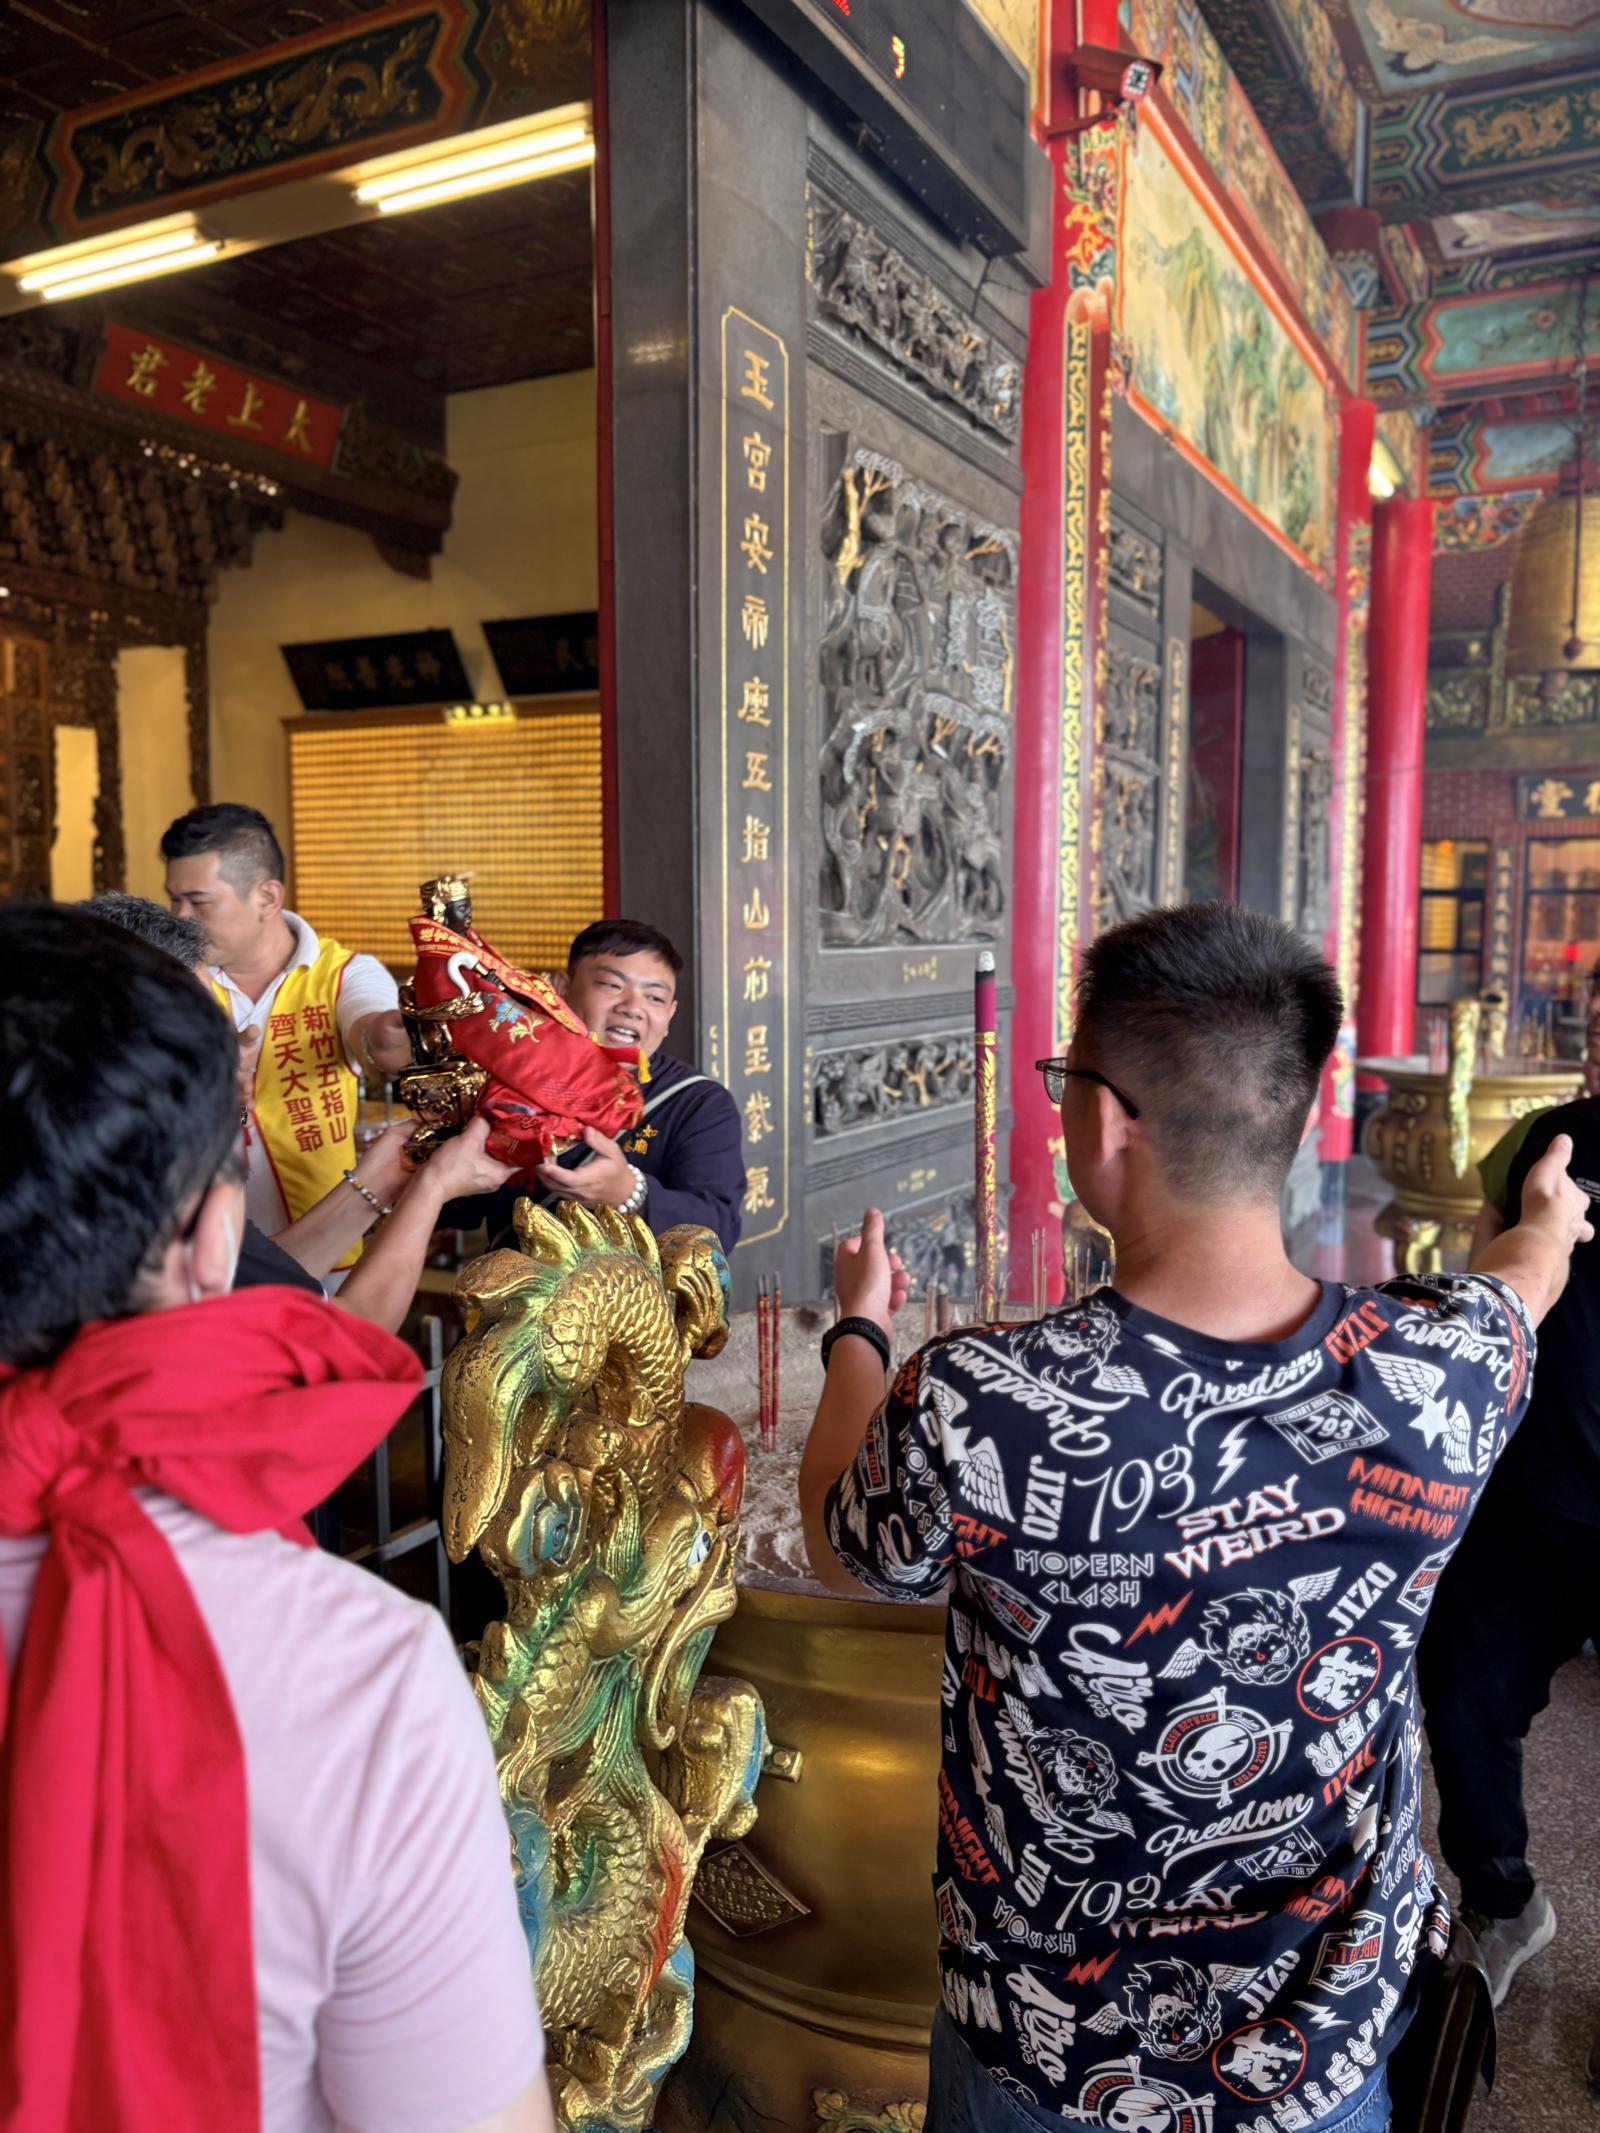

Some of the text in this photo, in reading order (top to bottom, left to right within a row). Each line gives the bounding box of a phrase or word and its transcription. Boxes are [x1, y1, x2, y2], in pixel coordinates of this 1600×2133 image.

[270, 1012, 324, 1153] 齊天大聖爺
[301, 1004, 348, 1144] 新竹五指山
[1324, 1301, 1390, 1364] JIZO
[947, 1338, 1112, 1456] Freedom
[1303, 1415, 1355, 1441] 793
[1360, 1430, 1384, 1446] SPEED
[1021, 1455, 1067, 1541] JIZO
[1072, 1443, 1196, 1542] 793
[1175, 1473, 1300, 1541] STAY
[1347, 1456, 1471, 1511] MIDNIGHT
[1349, 1488, 1459, 1540] HIGHWAY
[1013, 1548, 1155, 1580] MODERN
[1163, 1507, 1346, 1580] WEIRD
[1039, 1580, 1141, 1608] CLASH
[1327, 1562, 1398, 1637] JIZO
[1145, 1793, 1313, 1857] Freedom
[1237, 1950, 1300, 2020] JIZO
